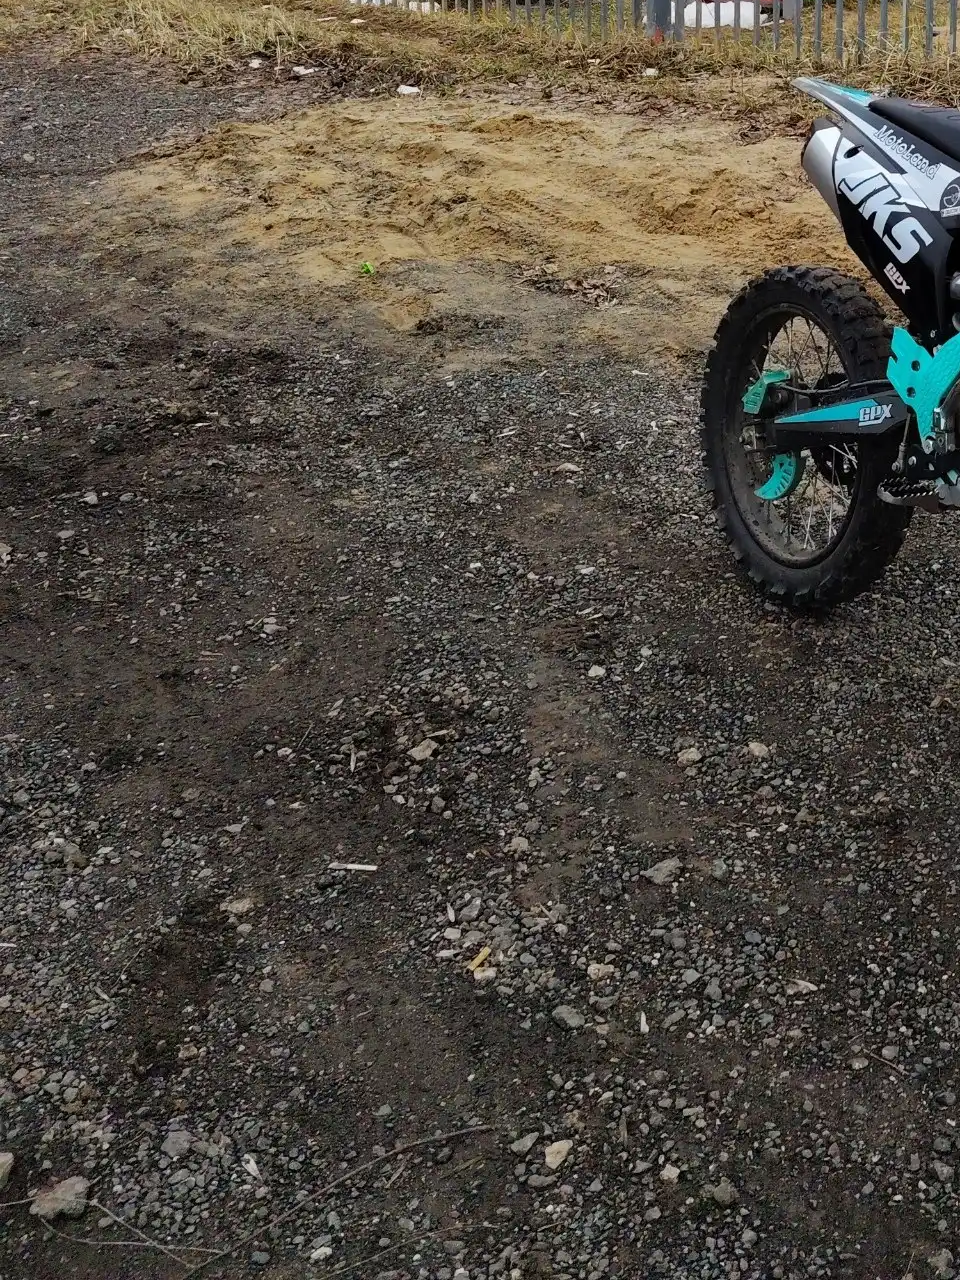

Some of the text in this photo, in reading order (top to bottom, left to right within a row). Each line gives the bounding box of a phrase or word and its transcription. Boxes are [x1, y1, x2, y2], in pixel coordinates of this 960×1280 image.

[874, 124, 941, 179] MotoLand
[837, 172, 934, 264] JKS
[883, 262, 911, 295] GPX
[858, 404, 893, 427] GPX
